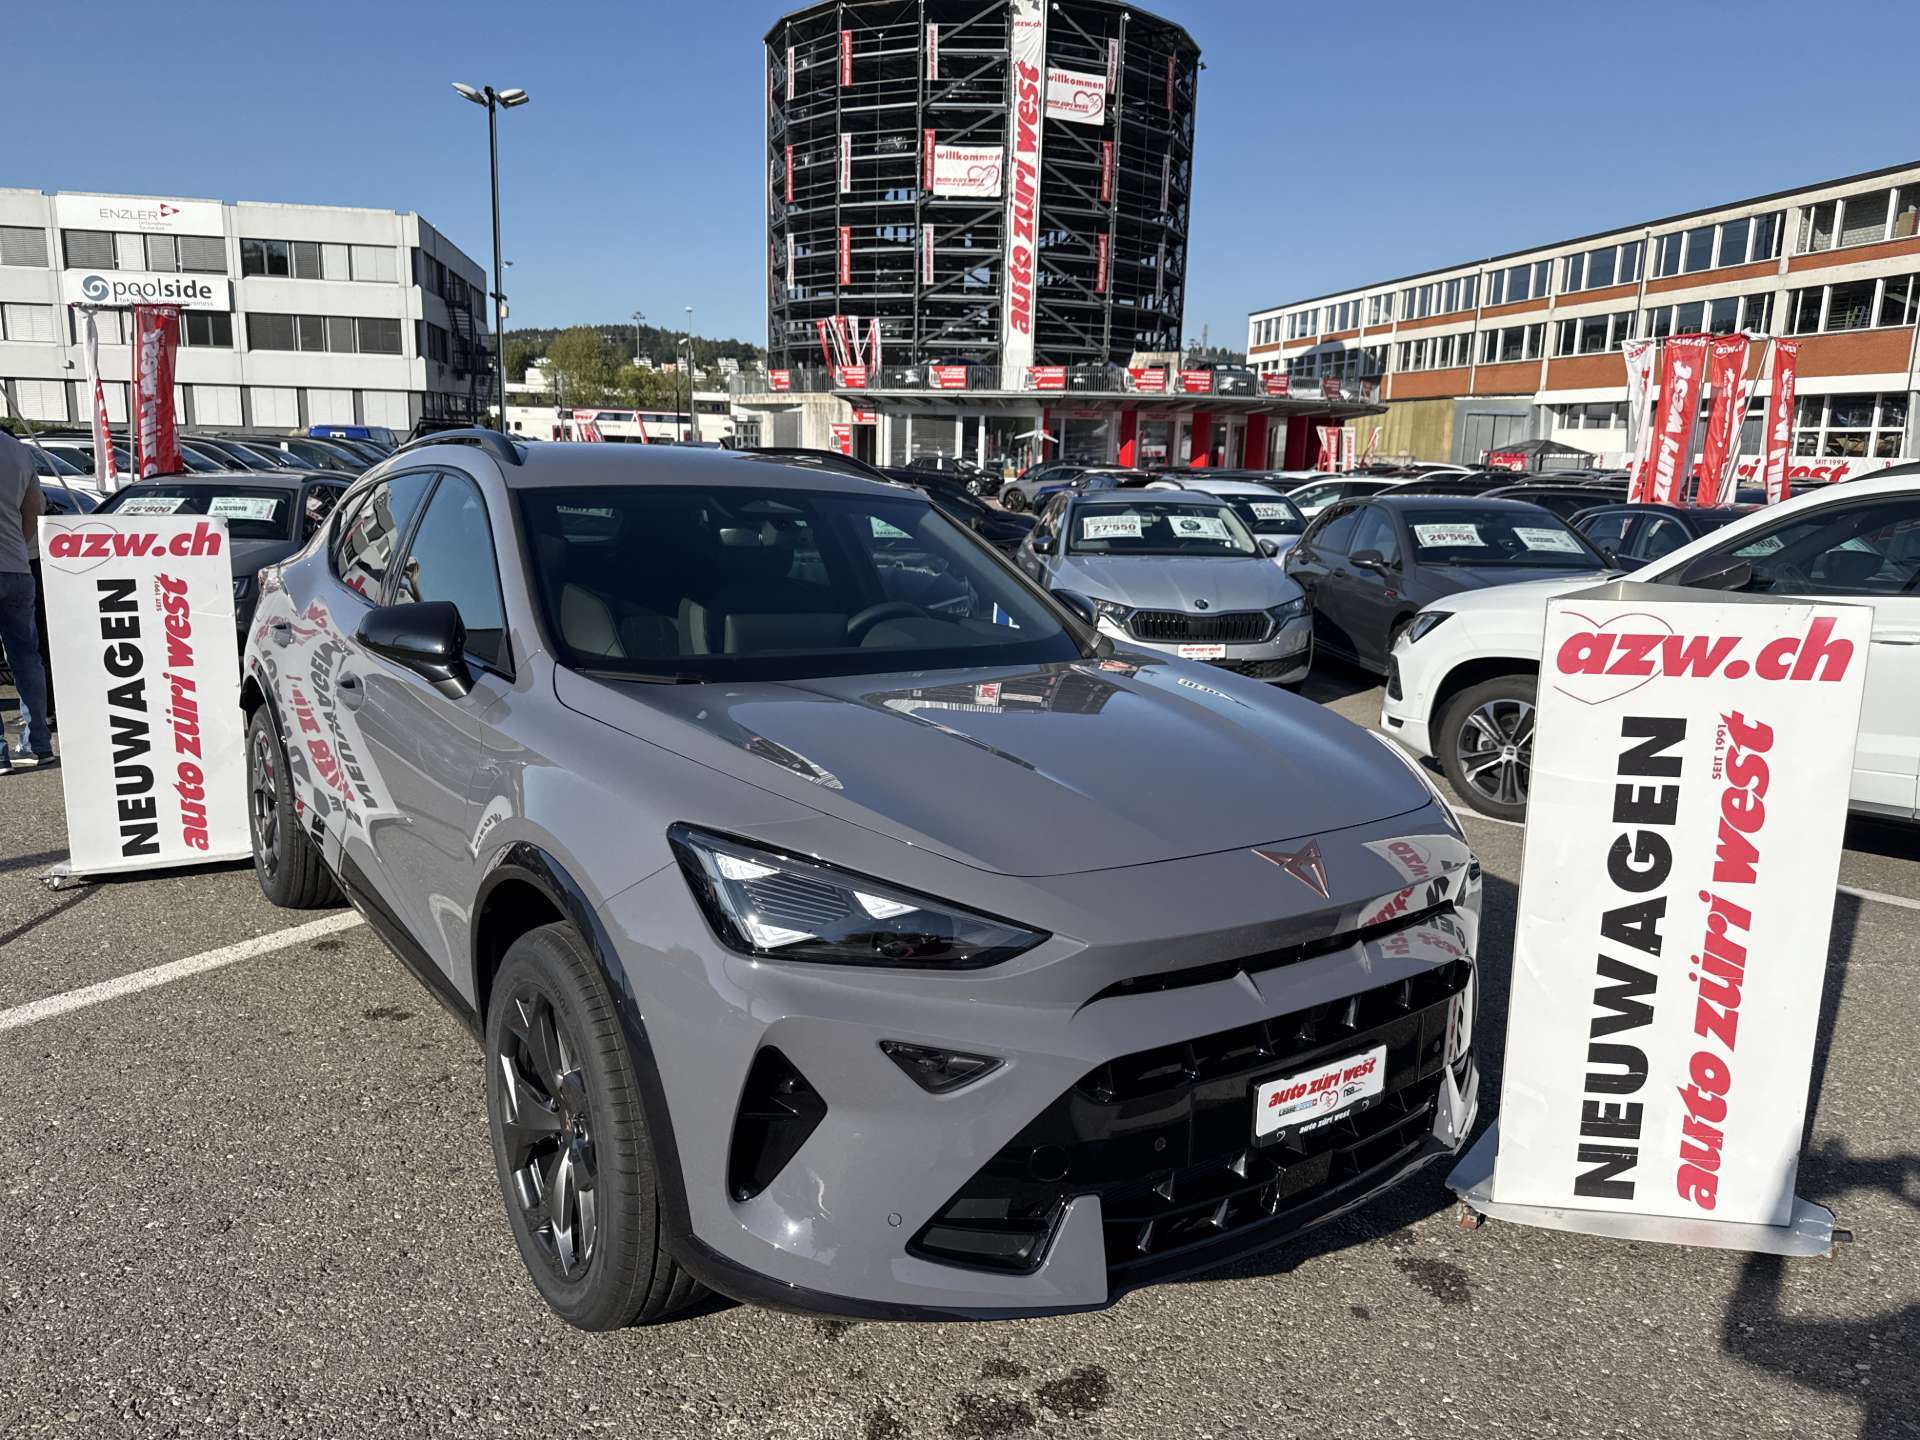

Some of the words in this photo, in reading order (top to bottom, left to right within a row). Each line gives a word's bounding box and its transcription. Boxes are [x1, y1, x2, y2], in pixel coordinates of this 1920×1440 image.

[1017, 60, 1040, 153] west
[1047, 73, 1104, 90] willkommen
[937, 150, 1001, 161] willkommen
[100, 208, 158, 220] ENZLER
[112, 278, 212, 302] poolside
[1010, 245, 1033, 335] auto
[1665, 360, 1692, 433] west
[48, 522, 222, 558] azw.ch
[154, 572, 193, 667] west
[1556, 616, 1854, 682] azw.ch
[97, 578, 160, 857] NEUWAGEN
[163, 672, 202, 759] züri
[1714, 724, 1727, 752] 1991
[1711, 757, 1724, 780] SEIT
[1713, 710, 1774, 884] west
[176, 762, 209, 851] auto
[1574, 716, 1687, 1200] NEUWAGEN
[1689, 890, 1752, 1052] züri
[1268, 1082, 1307, 1108] auto
[1307, 1068, 1343, 1095] züri
[1343, 1057, 1377, 1082] west
[1298, 1122, 1317, 1134] auto
[1334, 1109, 1351, 1121] west
[1677, 1050, 1732, 1211] auto
